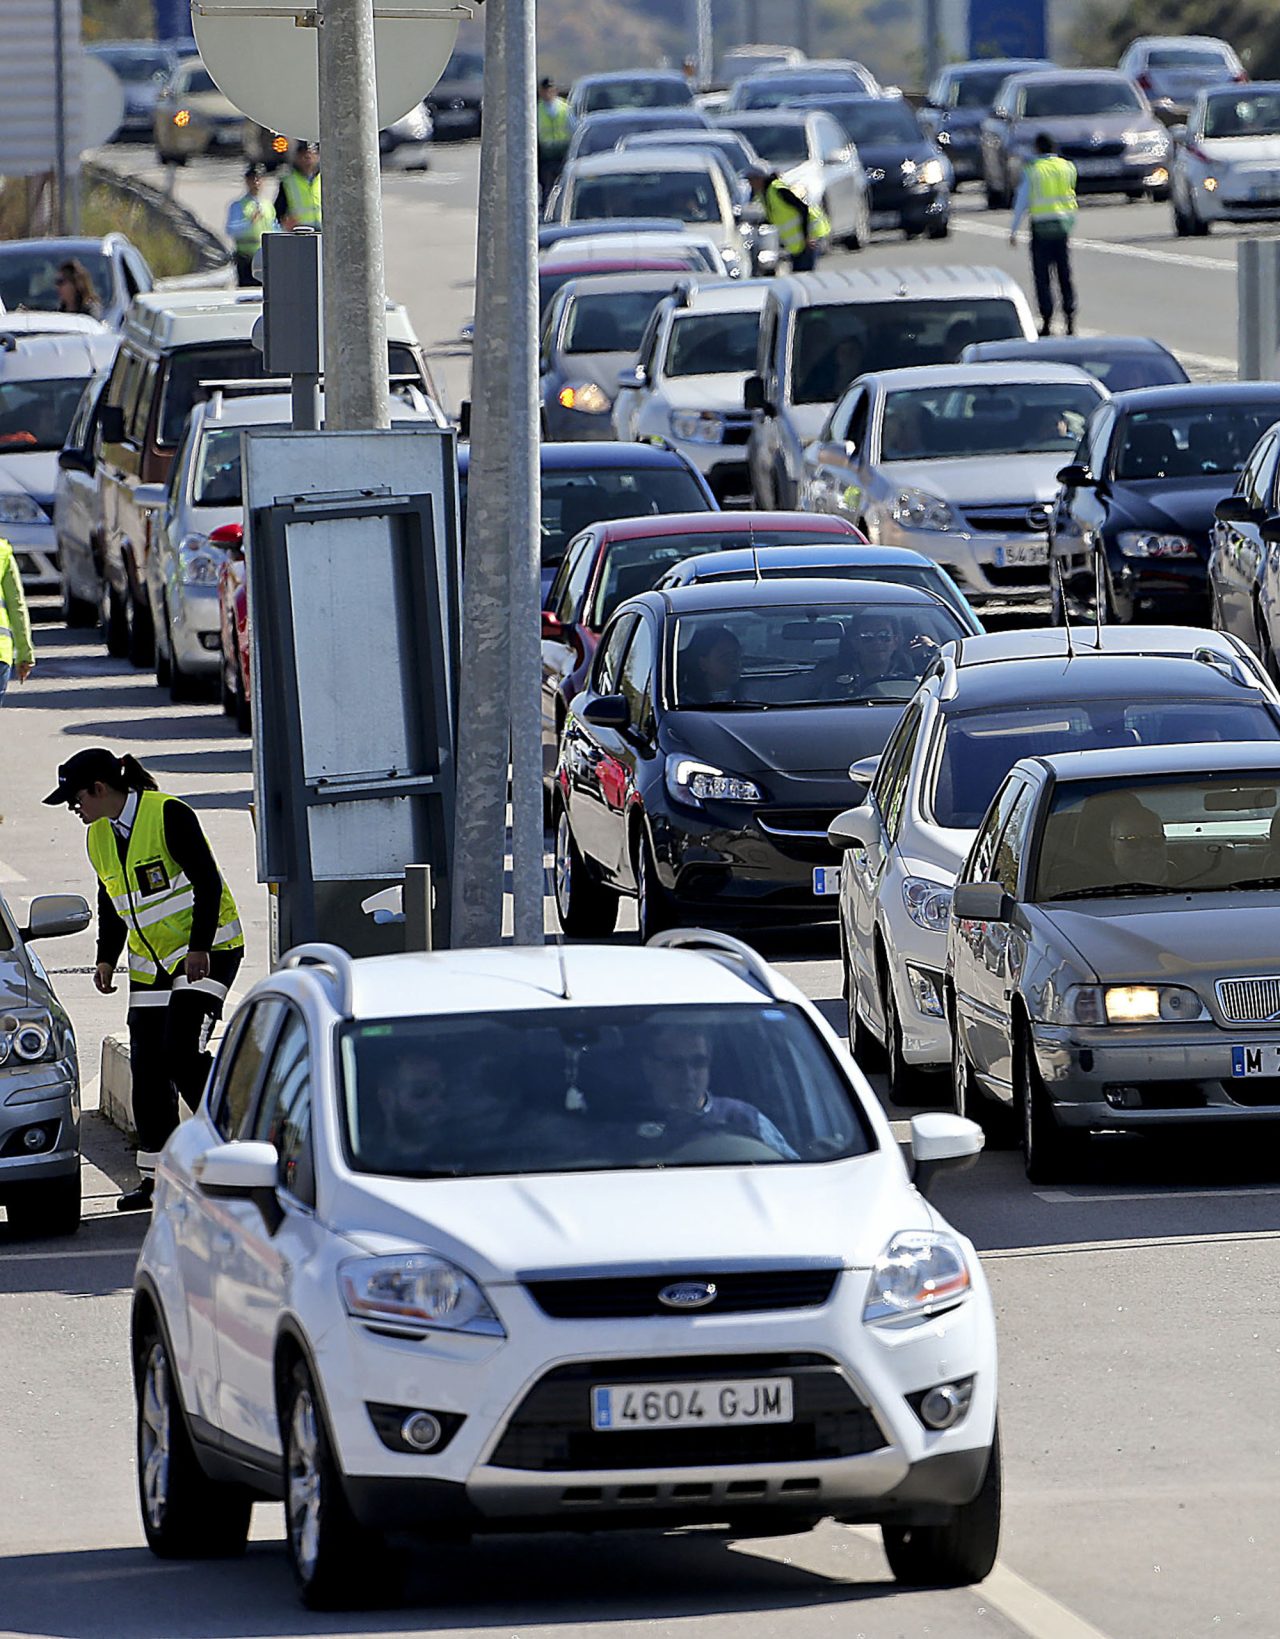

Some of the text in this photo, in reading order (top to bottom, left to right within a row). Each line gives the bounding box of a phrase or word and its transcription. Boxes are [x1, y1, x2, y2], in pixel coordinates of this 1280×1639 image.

[1246, 1048, 1262, 1073] M
[621, 1389, 705, 1421] 4604
[719, 1385, 782, 1418] GJM
